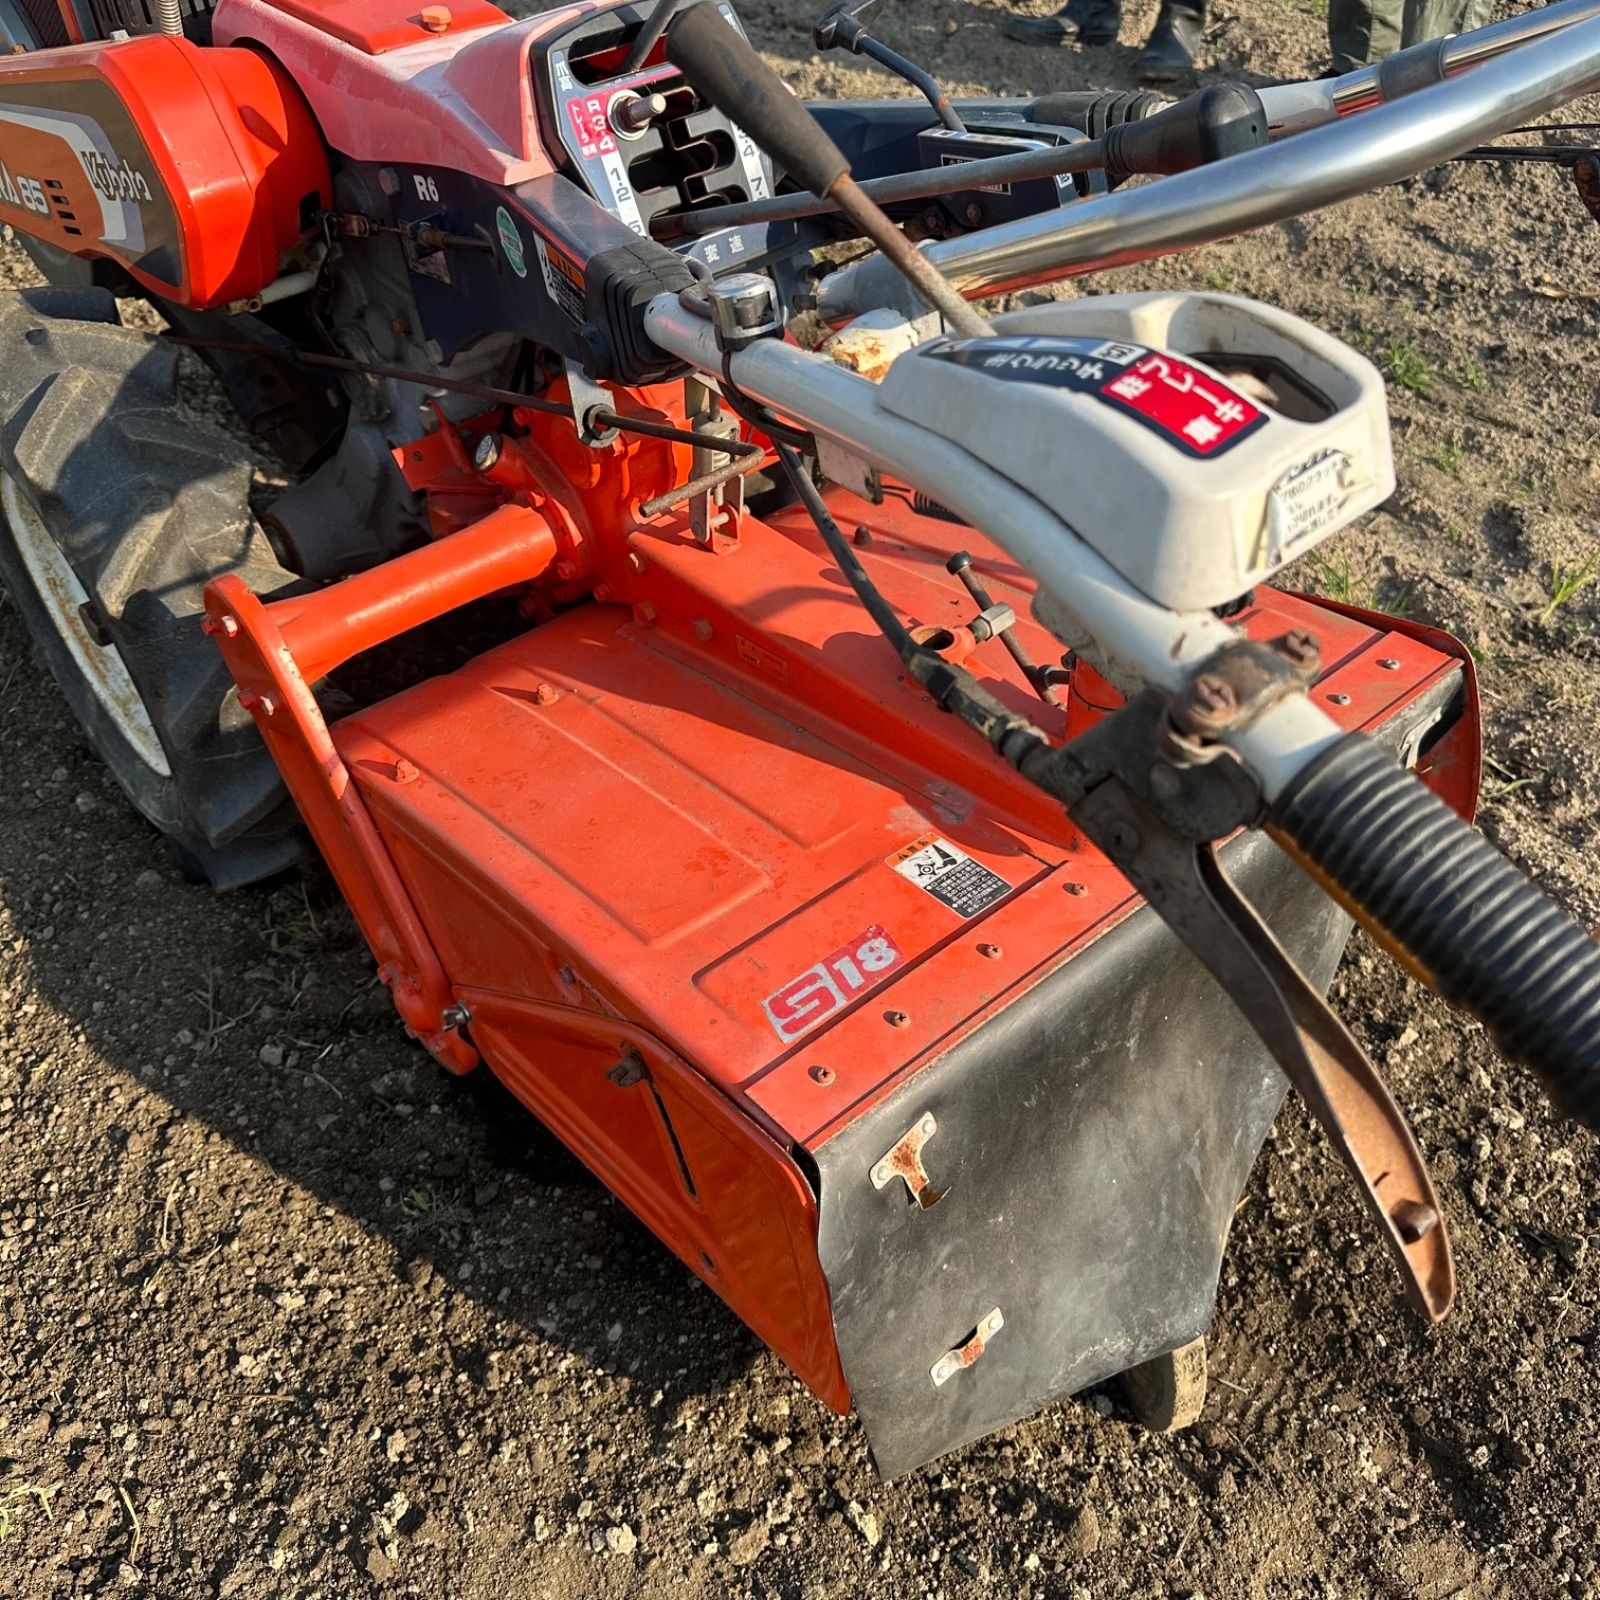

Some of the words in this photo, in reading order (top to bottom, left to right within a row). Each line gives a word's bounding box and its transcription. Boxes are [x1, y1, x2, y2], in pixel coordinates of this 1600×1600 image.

[586, 99, 602, 114] R
[17, 175, 49, 214] 85
[83, 151, 153, 202] Kubota
[412, 174, 440, 202] R6
[983, 351, 1104, 381] 主クラッチ
[1136, 356, 1246, 424] ブレーキ
[766, 936, 897, 1035] S18
